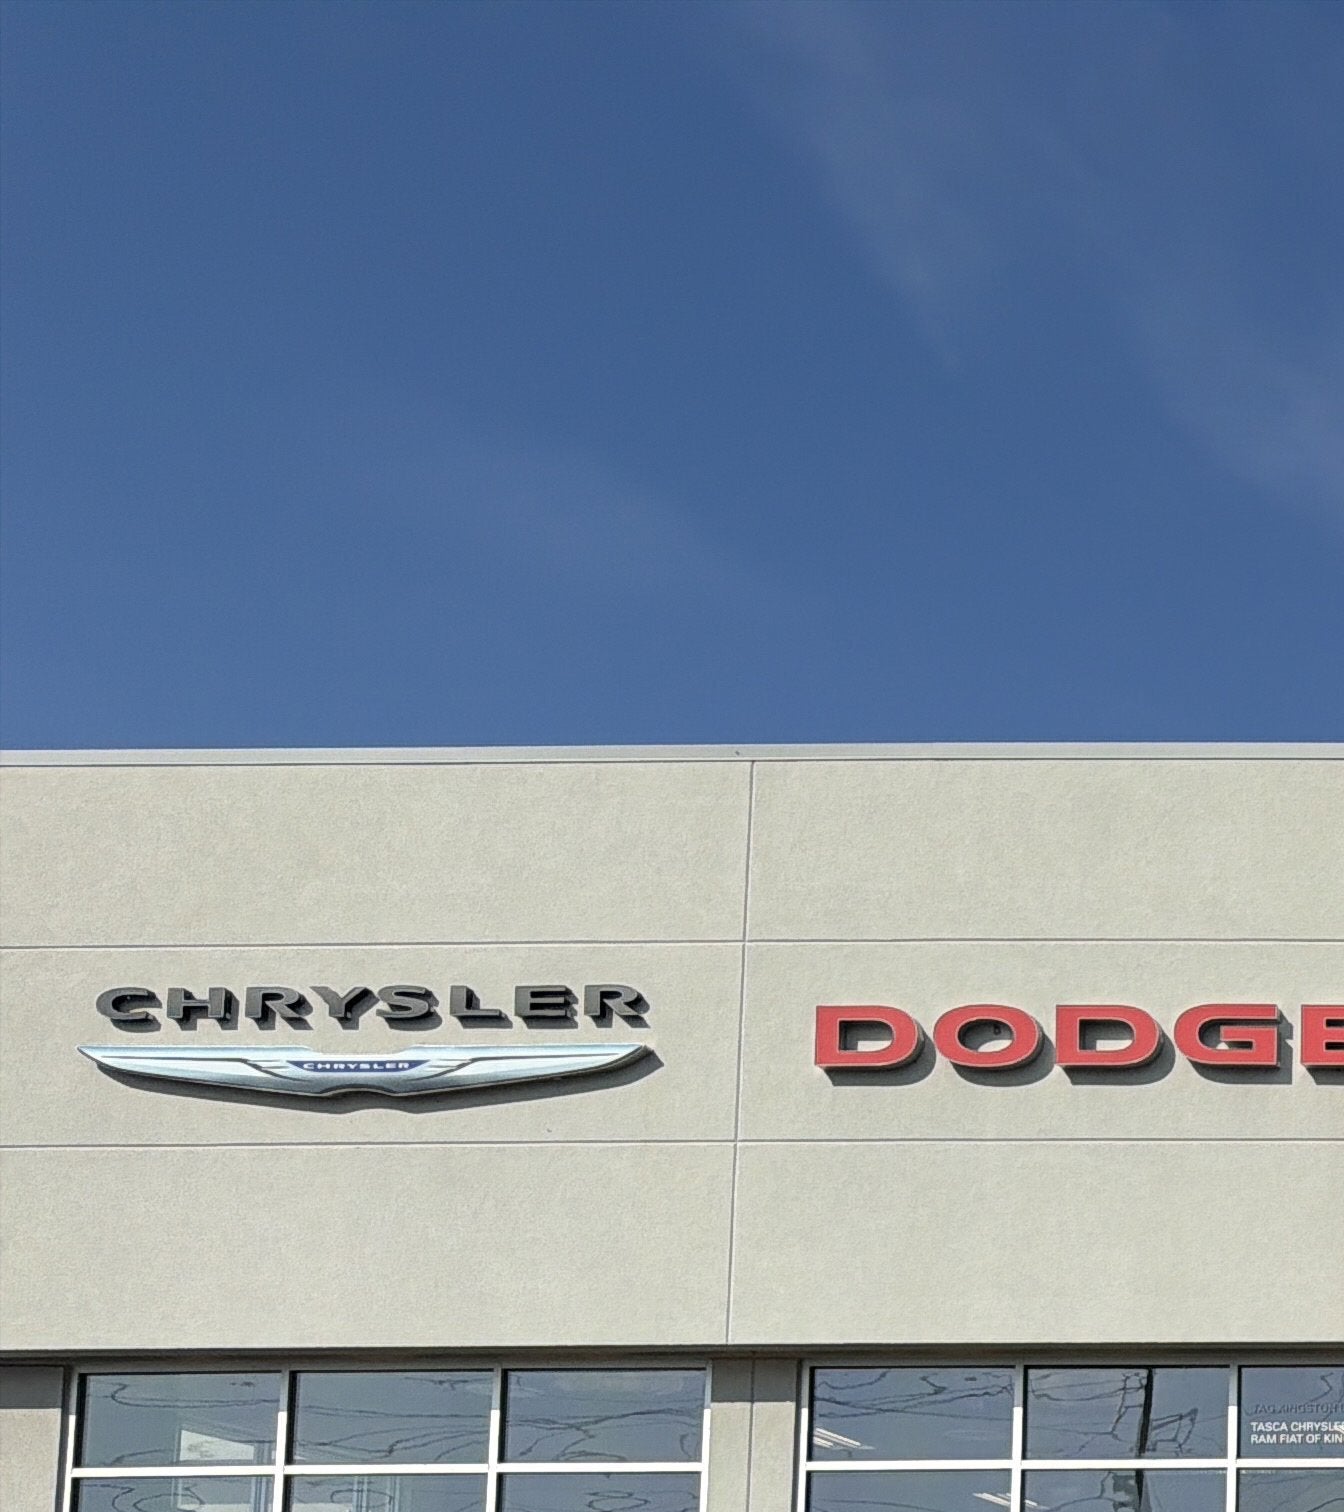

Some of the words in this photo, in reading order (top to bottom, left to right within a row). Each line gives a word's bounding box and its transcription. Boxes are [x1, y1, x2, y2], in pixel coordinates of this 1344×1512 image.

[98, 984, 648, 1024] CHRYSLER
[302, 1062, 410, 1070] CHRYSLER
[1250, 1421, 1288, 1432] TASCA
[1250, 1433, 1277, 1445] RAM
[1279, 1433, 1304, 1444] FIAT
[1305, 1433, 1321, 1444] OF
